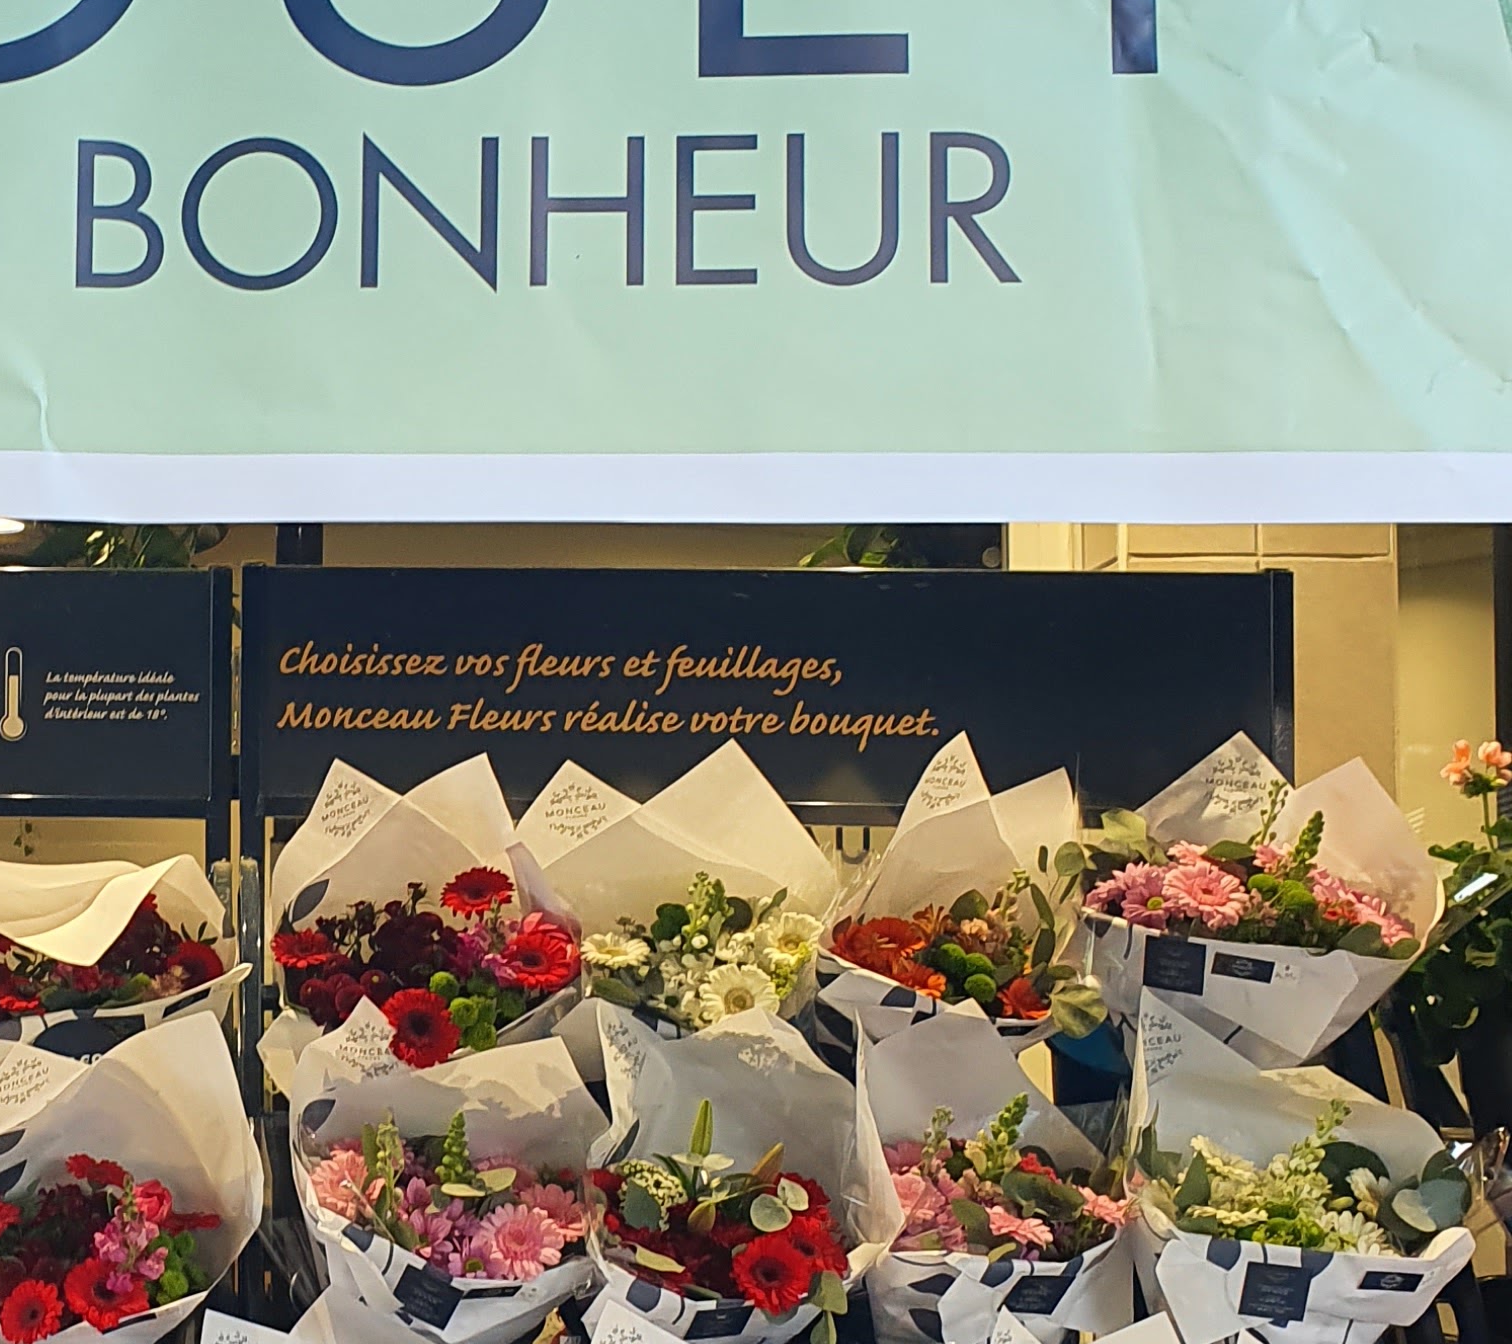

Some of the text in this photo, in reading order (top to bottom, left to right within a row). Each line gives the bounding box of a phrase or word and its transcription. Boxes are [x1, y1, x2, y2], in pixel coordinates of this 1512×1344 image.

[74, 132, 1021, 293] BONHEUR
[279, 641, 842, 695] Choisissez vos fleurs et feuillages,
[46, 671, 62, 683] La
[63, 671, 136, 688] température
[43, 688, 200, 706] pour la plupart des plantes
[109, 709, 126, 719] est
[128, 708, 144, 720] de
[276, 697, 939, 752] Monceau Fleurs réalise votre bouquet.
[1206, 777, 1267, 790] MONCEAU
[322, 796, 370, 822] MONCEAU
[545, 802, 606, 819] MONCEAU
